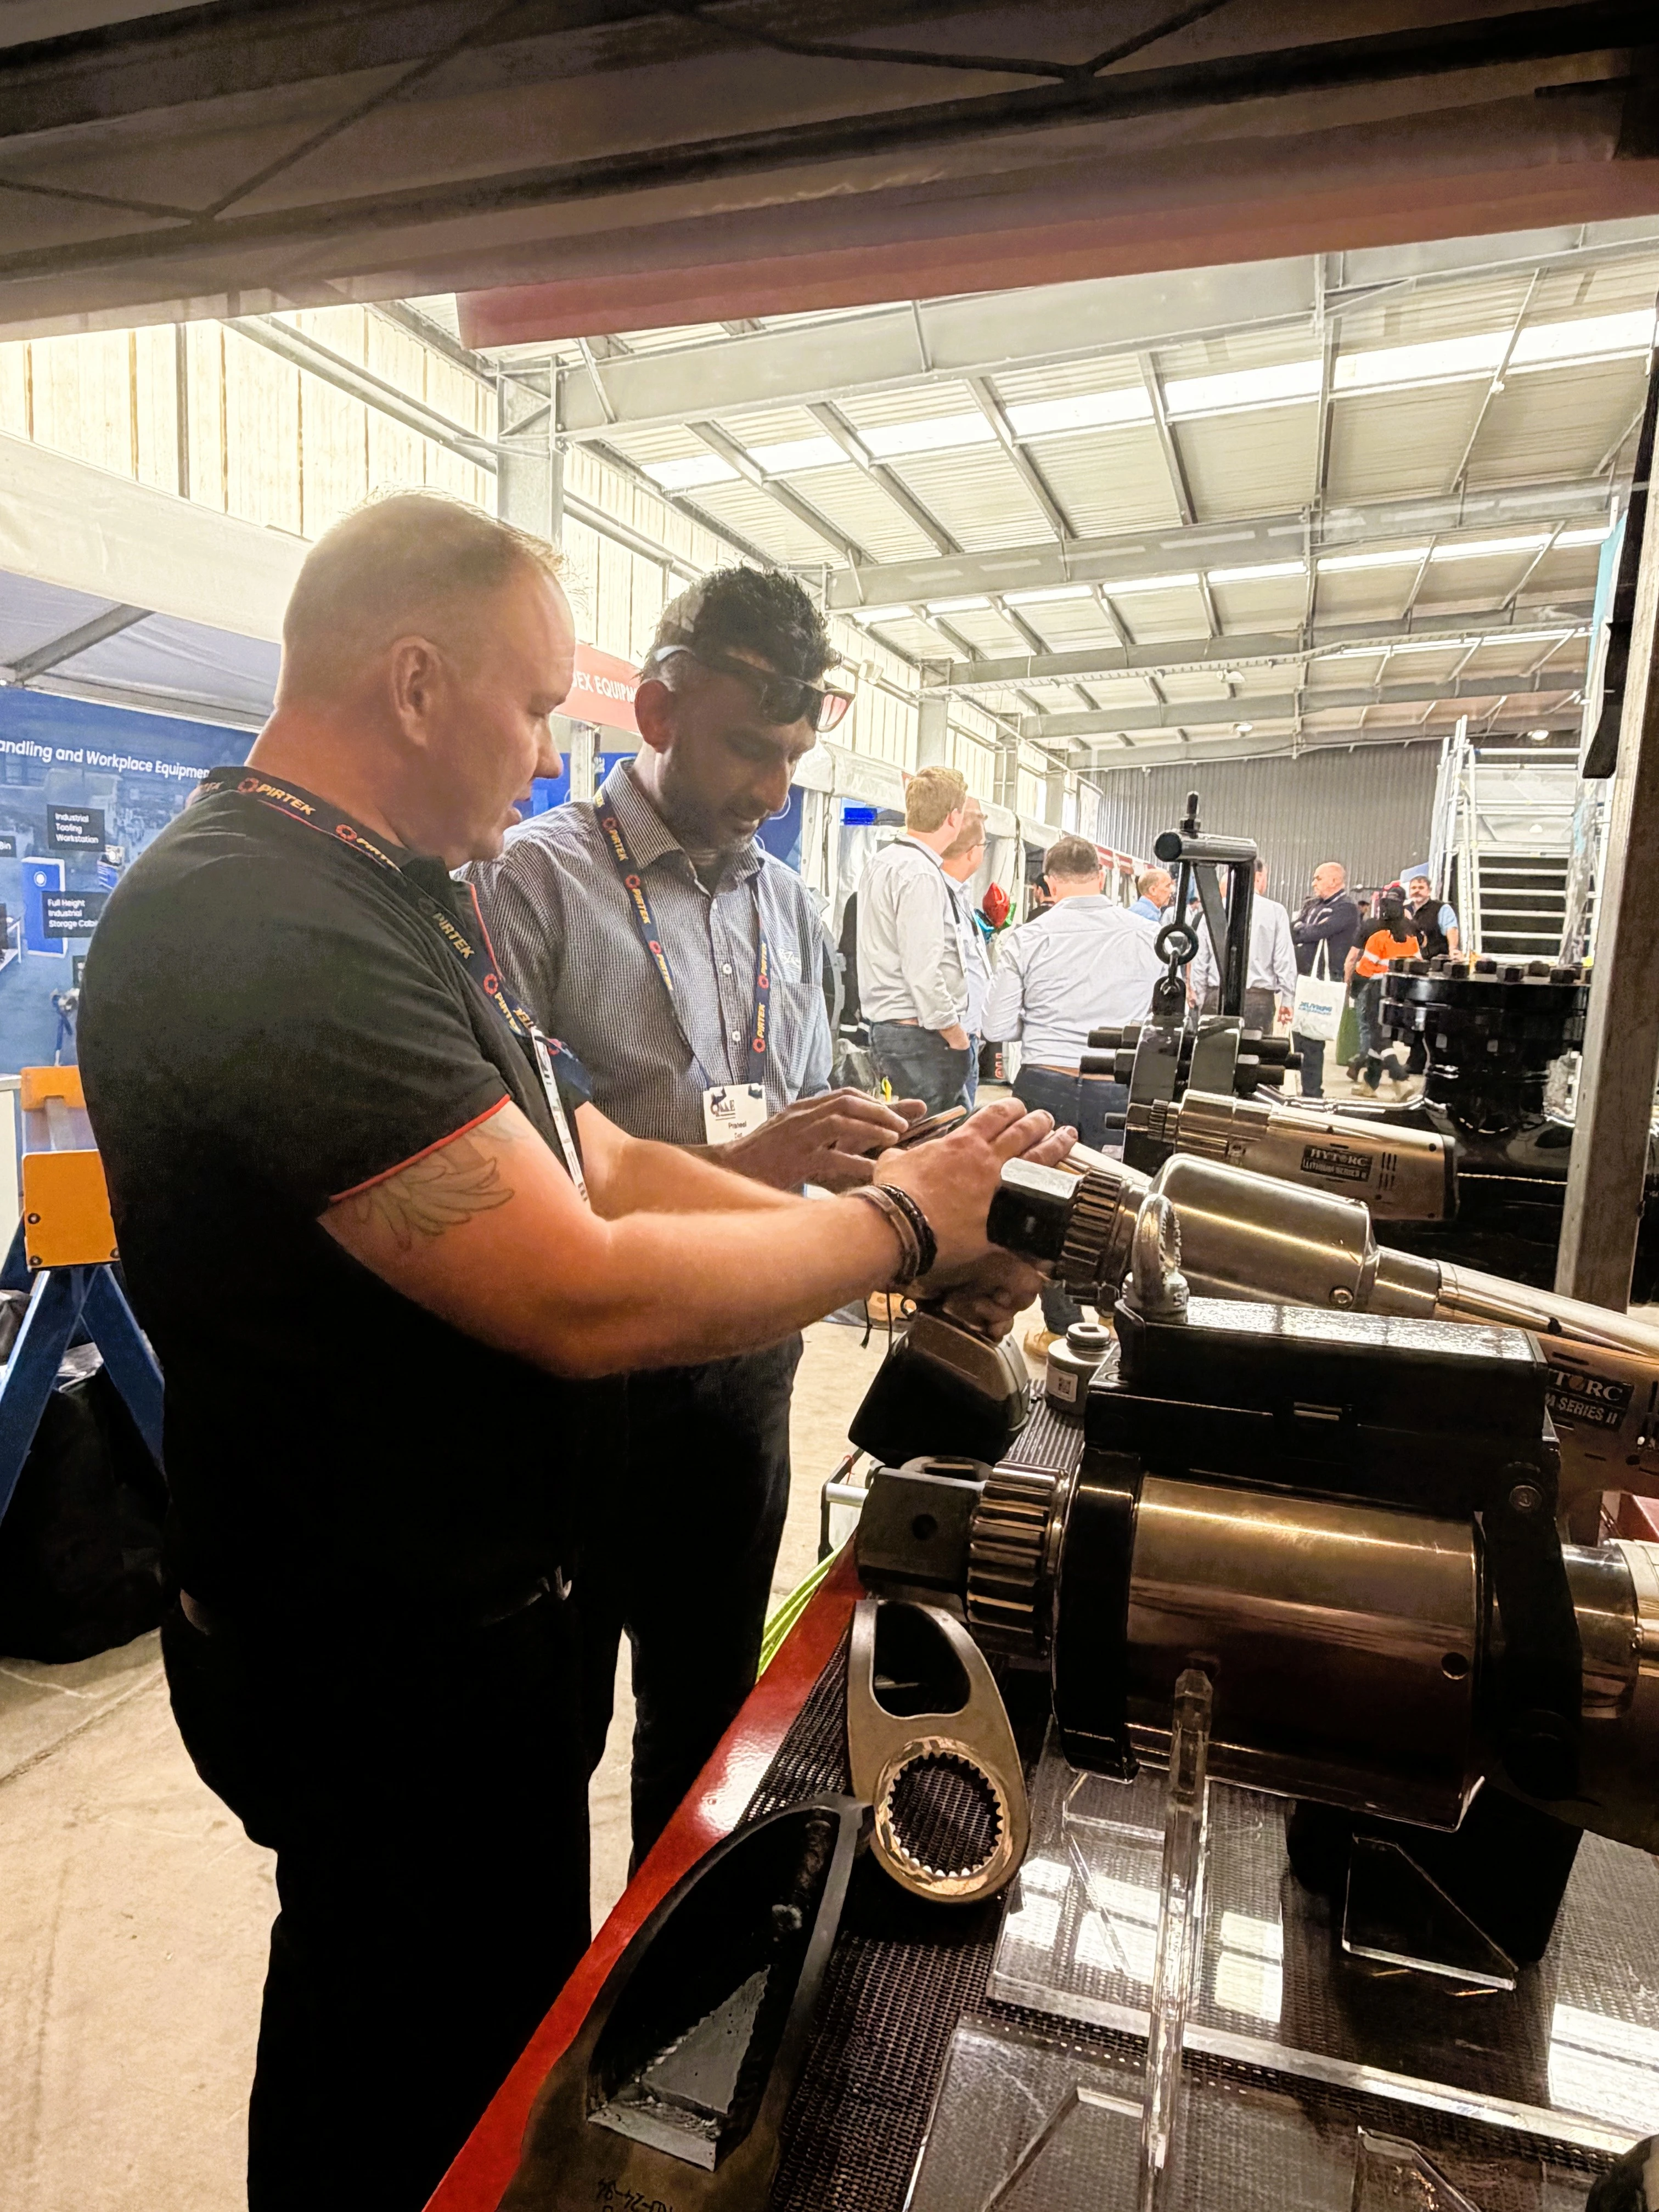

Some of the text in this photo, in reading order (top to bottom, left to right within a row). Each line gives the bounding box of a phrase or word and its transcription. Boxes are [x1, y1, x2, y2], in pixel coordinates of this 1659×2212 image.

[55, 748, 83, 763] and
[86, 750, 153, 773] Workplace
[256, 784, 317, 815] PIRTEK
[55, 813, 89, 823] Industrial
[55, 834, 99, 843] Workstation
[608, 829, 629, 862] PIRTEK
[47, 899, 86, 909] Full Height
[48, 909, 82, 918] Industrial
[632, 888, 651, 925] PIRTEK
[49, 920, 77, 930] Storage
[432, 912, 475, 960] PIRTEK
[757, 1002, 766, 1039] PIRTEK
[1557, 1397, 1605, 1421] SERIES
